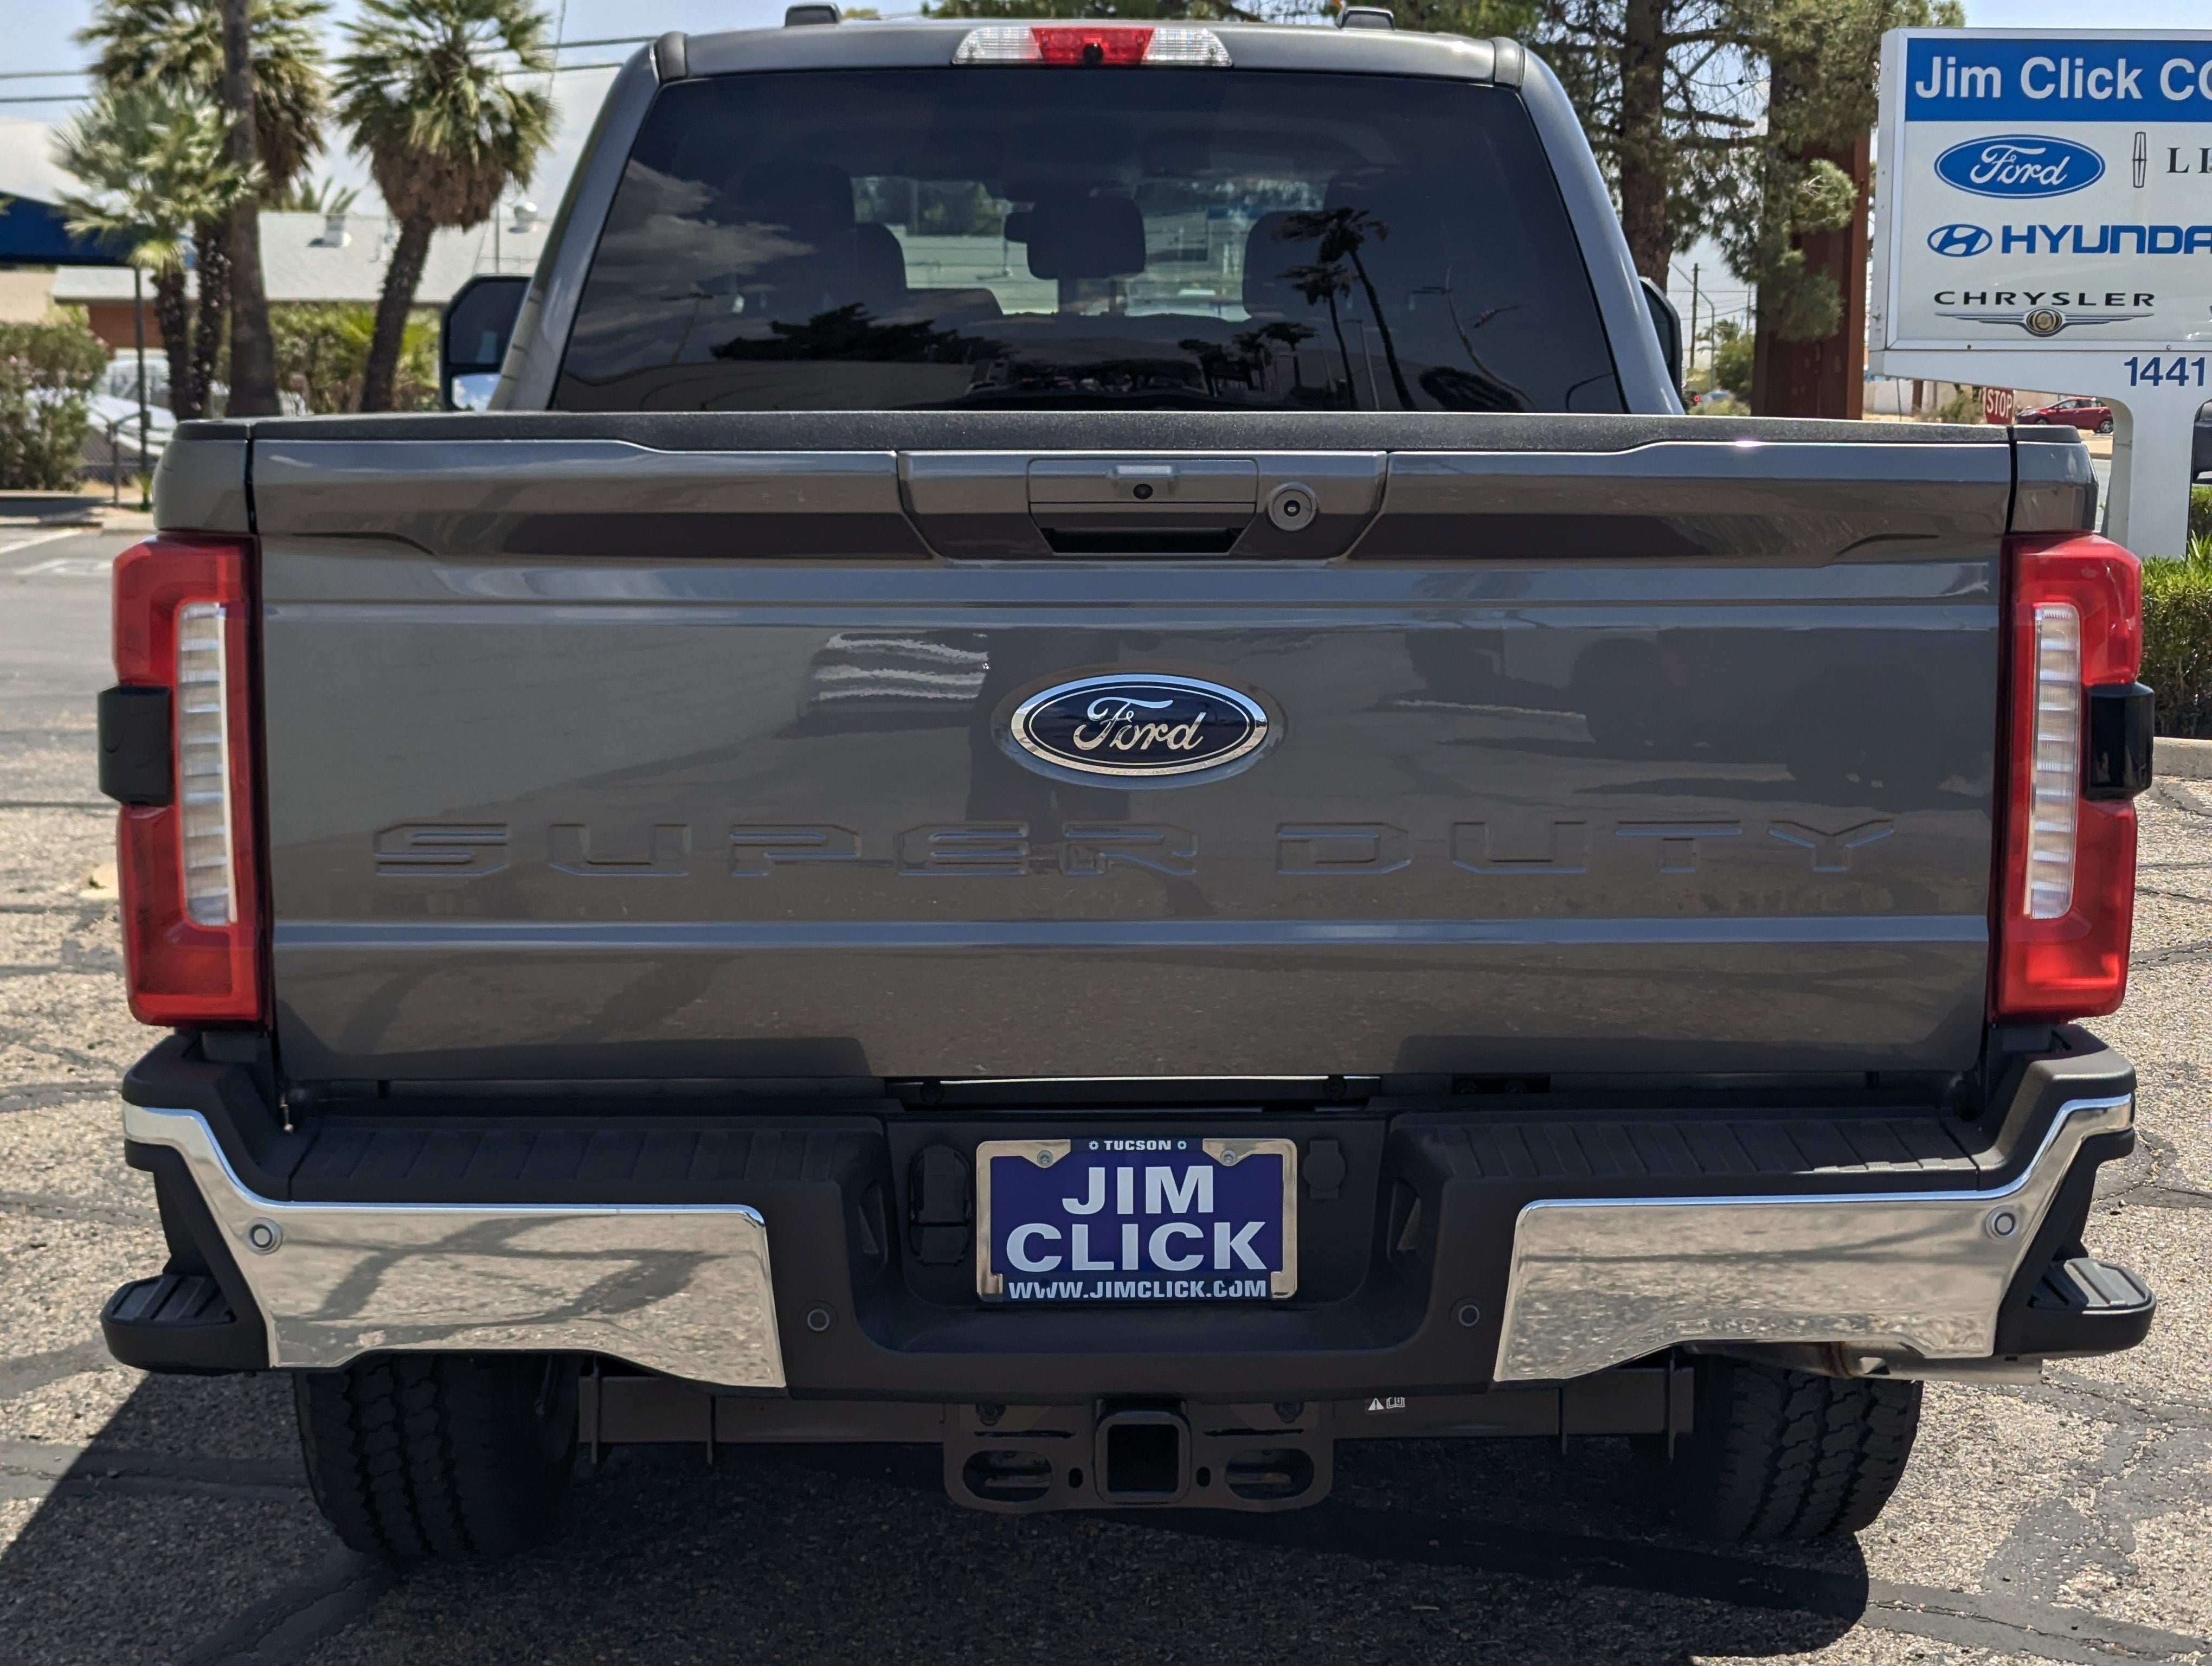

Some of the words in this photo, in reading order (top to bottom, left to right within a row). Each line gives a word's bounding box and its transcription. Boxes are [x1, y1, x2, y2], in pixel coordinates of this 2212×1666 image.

[1915, 56, 2002, 99] Jim
[2020, 56, 2143, 99] Click
[1970, 144, 2070, 185] Ford
[1934, 291, 2155, 307] CHRYSLER
[2124, 356, 2205, 387] 1441
[1986, 388, 2012, 419] STOP
[1073, 696, 1207, 751] Ford
[372, 822, 1200, 877] SUPER
[1276, 820, 1895, 875] DUTY
[1103, 1140, 1172, 1151] TUCSON
[1062, 1165, 1214, 1215] JIM
[1006, 1221, 1268, 1273] CLICK
[1008, 1280, 1267, 1299] WWW.JIMCLICK.COM
